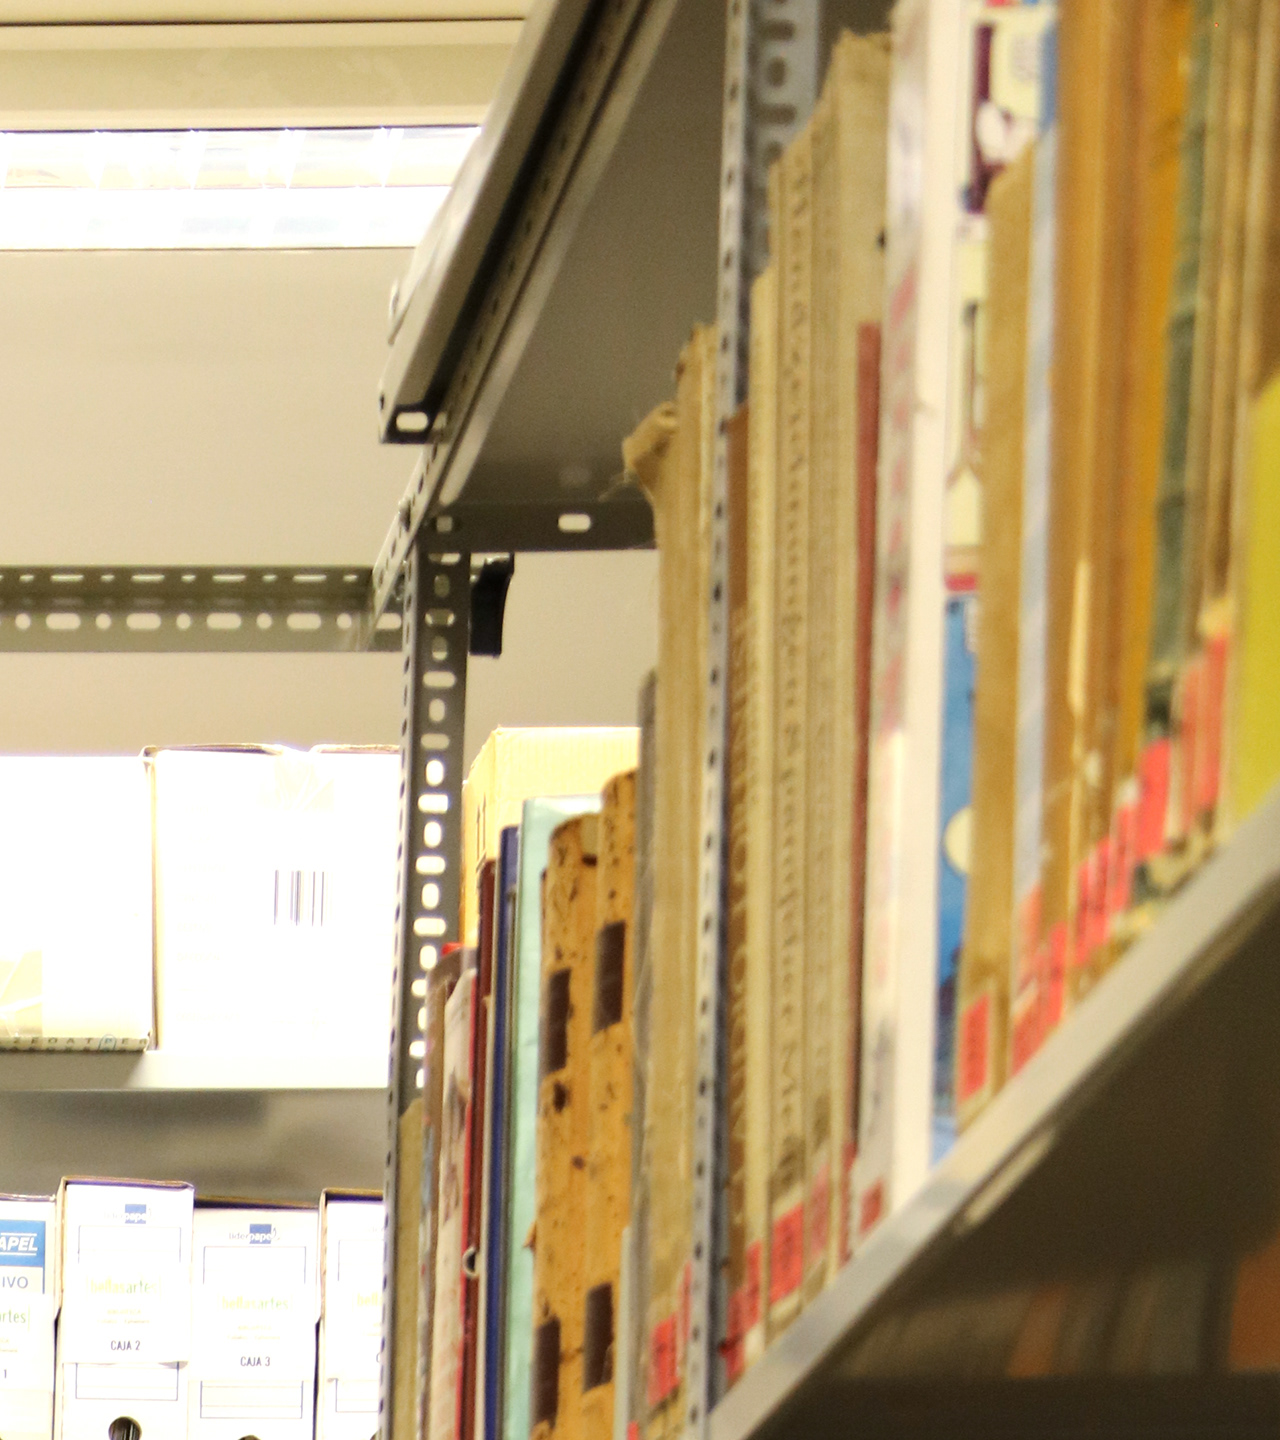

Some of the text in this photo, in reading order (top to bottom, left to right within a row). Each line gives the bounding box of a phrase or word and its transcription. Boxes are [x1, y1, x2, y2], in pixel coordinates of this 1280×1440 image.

[111, 1340, 141, 1351] CAJA 2
[241, 1355, 270, 1367] CAJA 3
